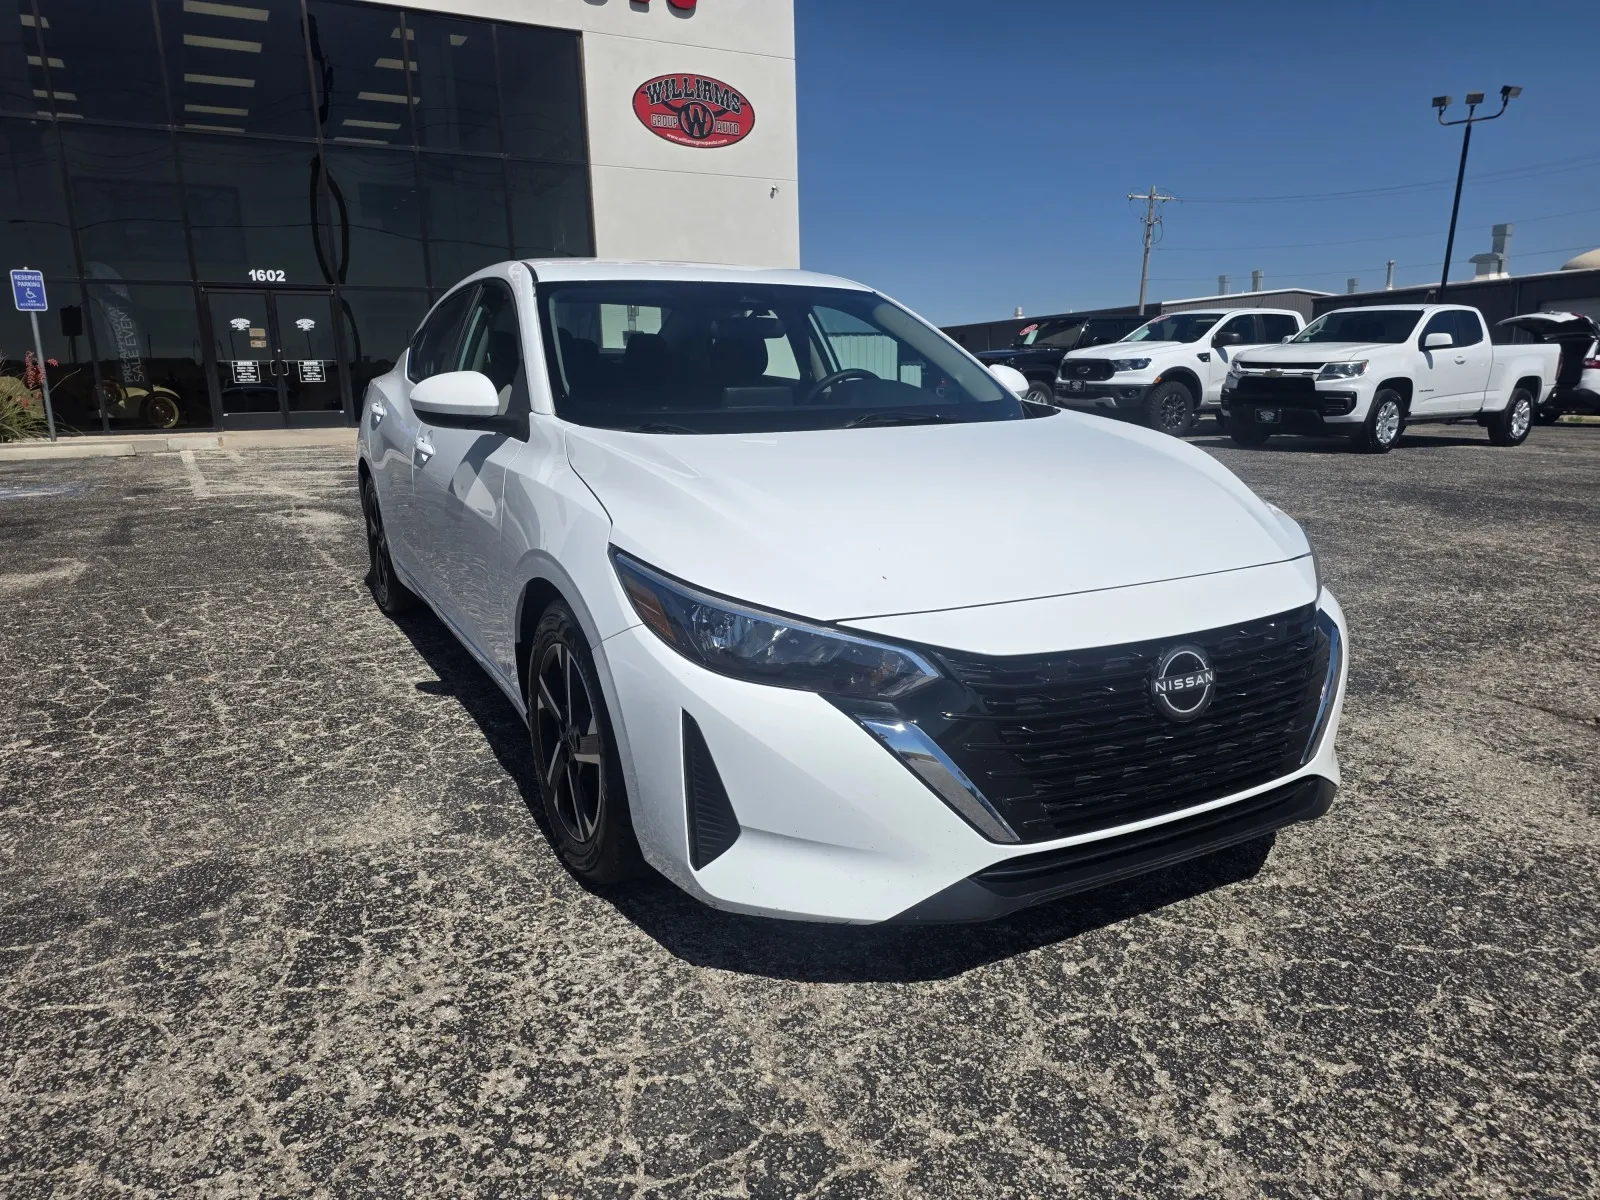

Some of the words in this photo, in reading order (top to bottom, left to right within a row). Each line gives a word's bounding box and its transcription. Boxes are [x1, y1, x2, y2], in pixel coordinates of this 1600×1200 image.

[646, 77, 741, 114] WILLIAMS
[651, 114, 678, 128] GROUP
[716, 121, 740, 135] AUTO
[666, 132, 728, 146] www.williamsgroupauto.com
[248, 269, 286, 282] 1602
[128, 349, 145, 382] SALE
[1155, 671, 1213, 692] NISSAN
